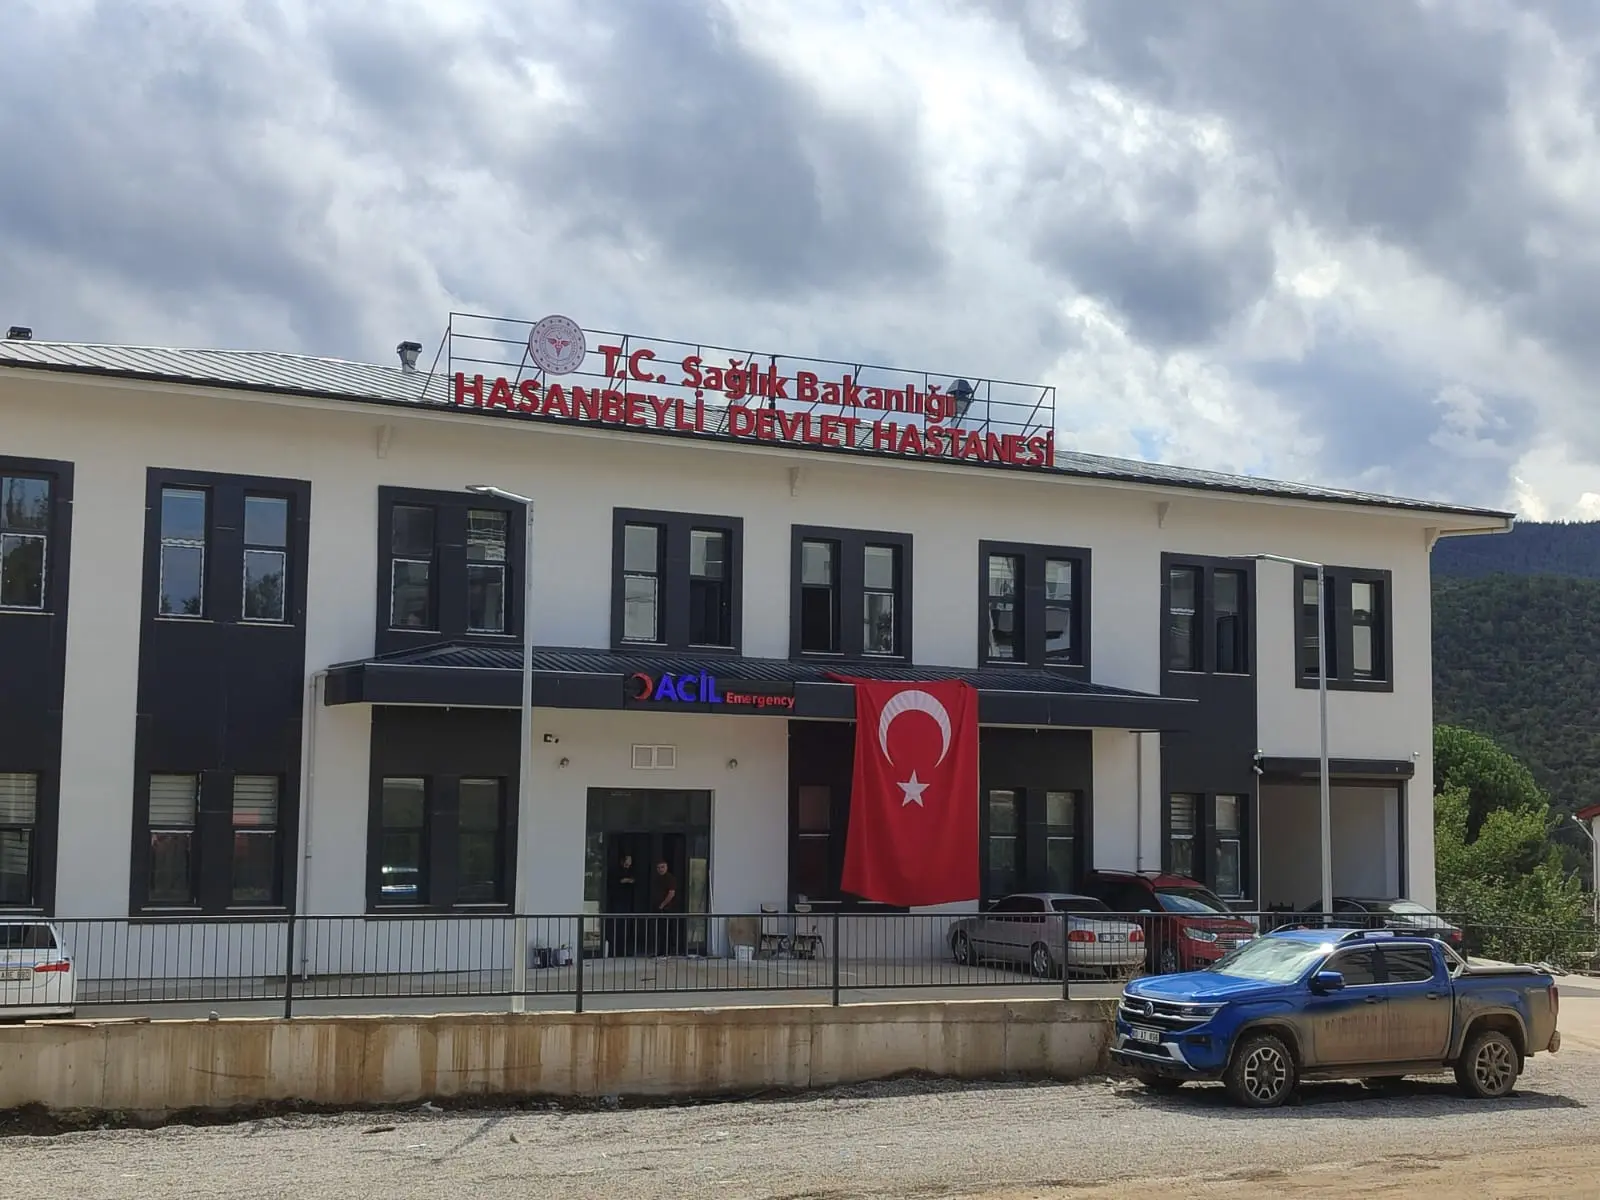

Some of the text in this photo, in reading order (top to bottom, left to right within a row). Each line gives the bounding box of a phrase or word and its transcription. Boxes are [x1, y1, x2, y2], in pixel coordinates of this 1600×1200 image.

[454, 372, 1055, 467] HASANBEYLİ DEVLET HASTANESİ
[598, 345, 666, 384] T.C.
[681, 355, 789, 400] Sağlık
[796, 371, 956, 424] Bakanlığı
[655, 669, 795, 709] ACİL Emergency
